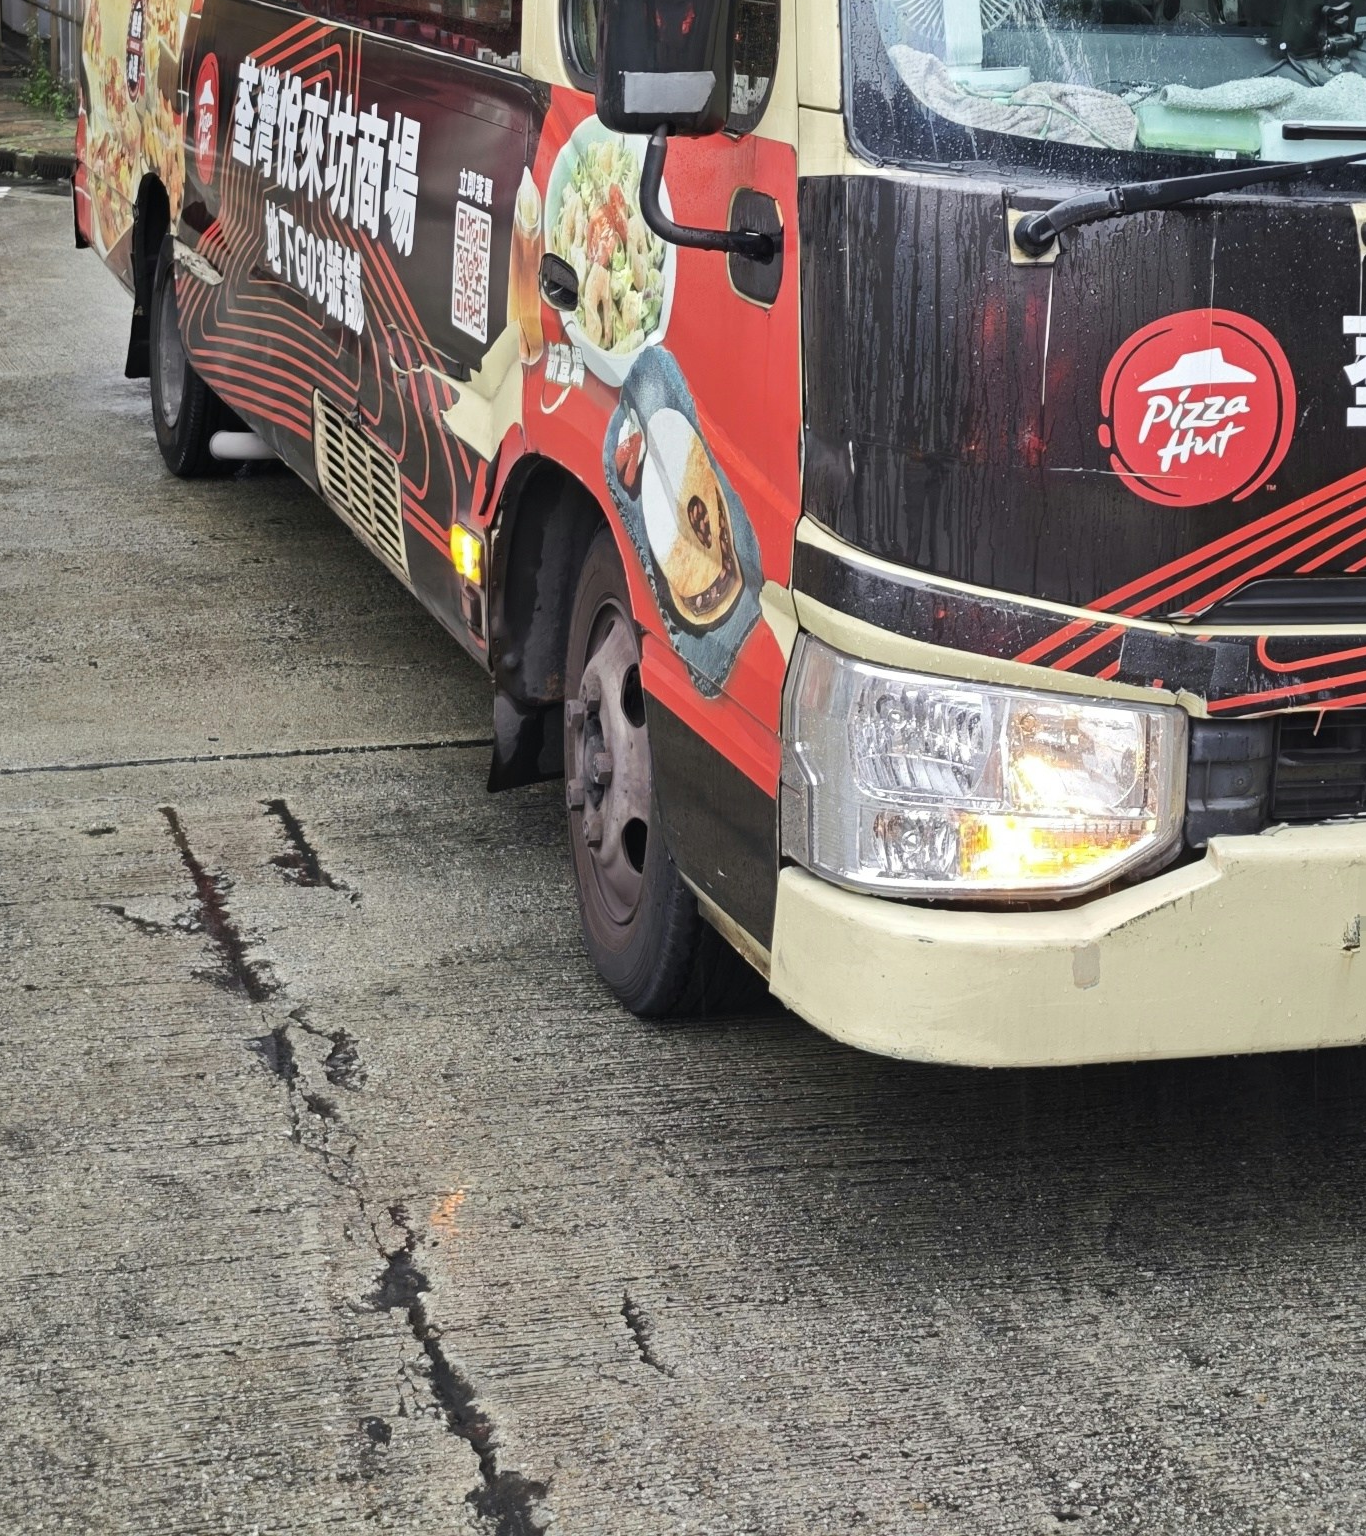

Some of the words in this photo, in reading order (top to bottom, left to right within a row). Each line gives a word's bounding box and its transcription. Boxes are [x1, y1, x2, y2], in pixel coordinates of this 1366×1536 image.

[232, 56, 421, 257] 荃灣悅來坊商場
[458, 168, 494, 207] 立即落單
[1138, 387, 1251, 444] Pizza
[1157, 422, 1245, 473] Hut
